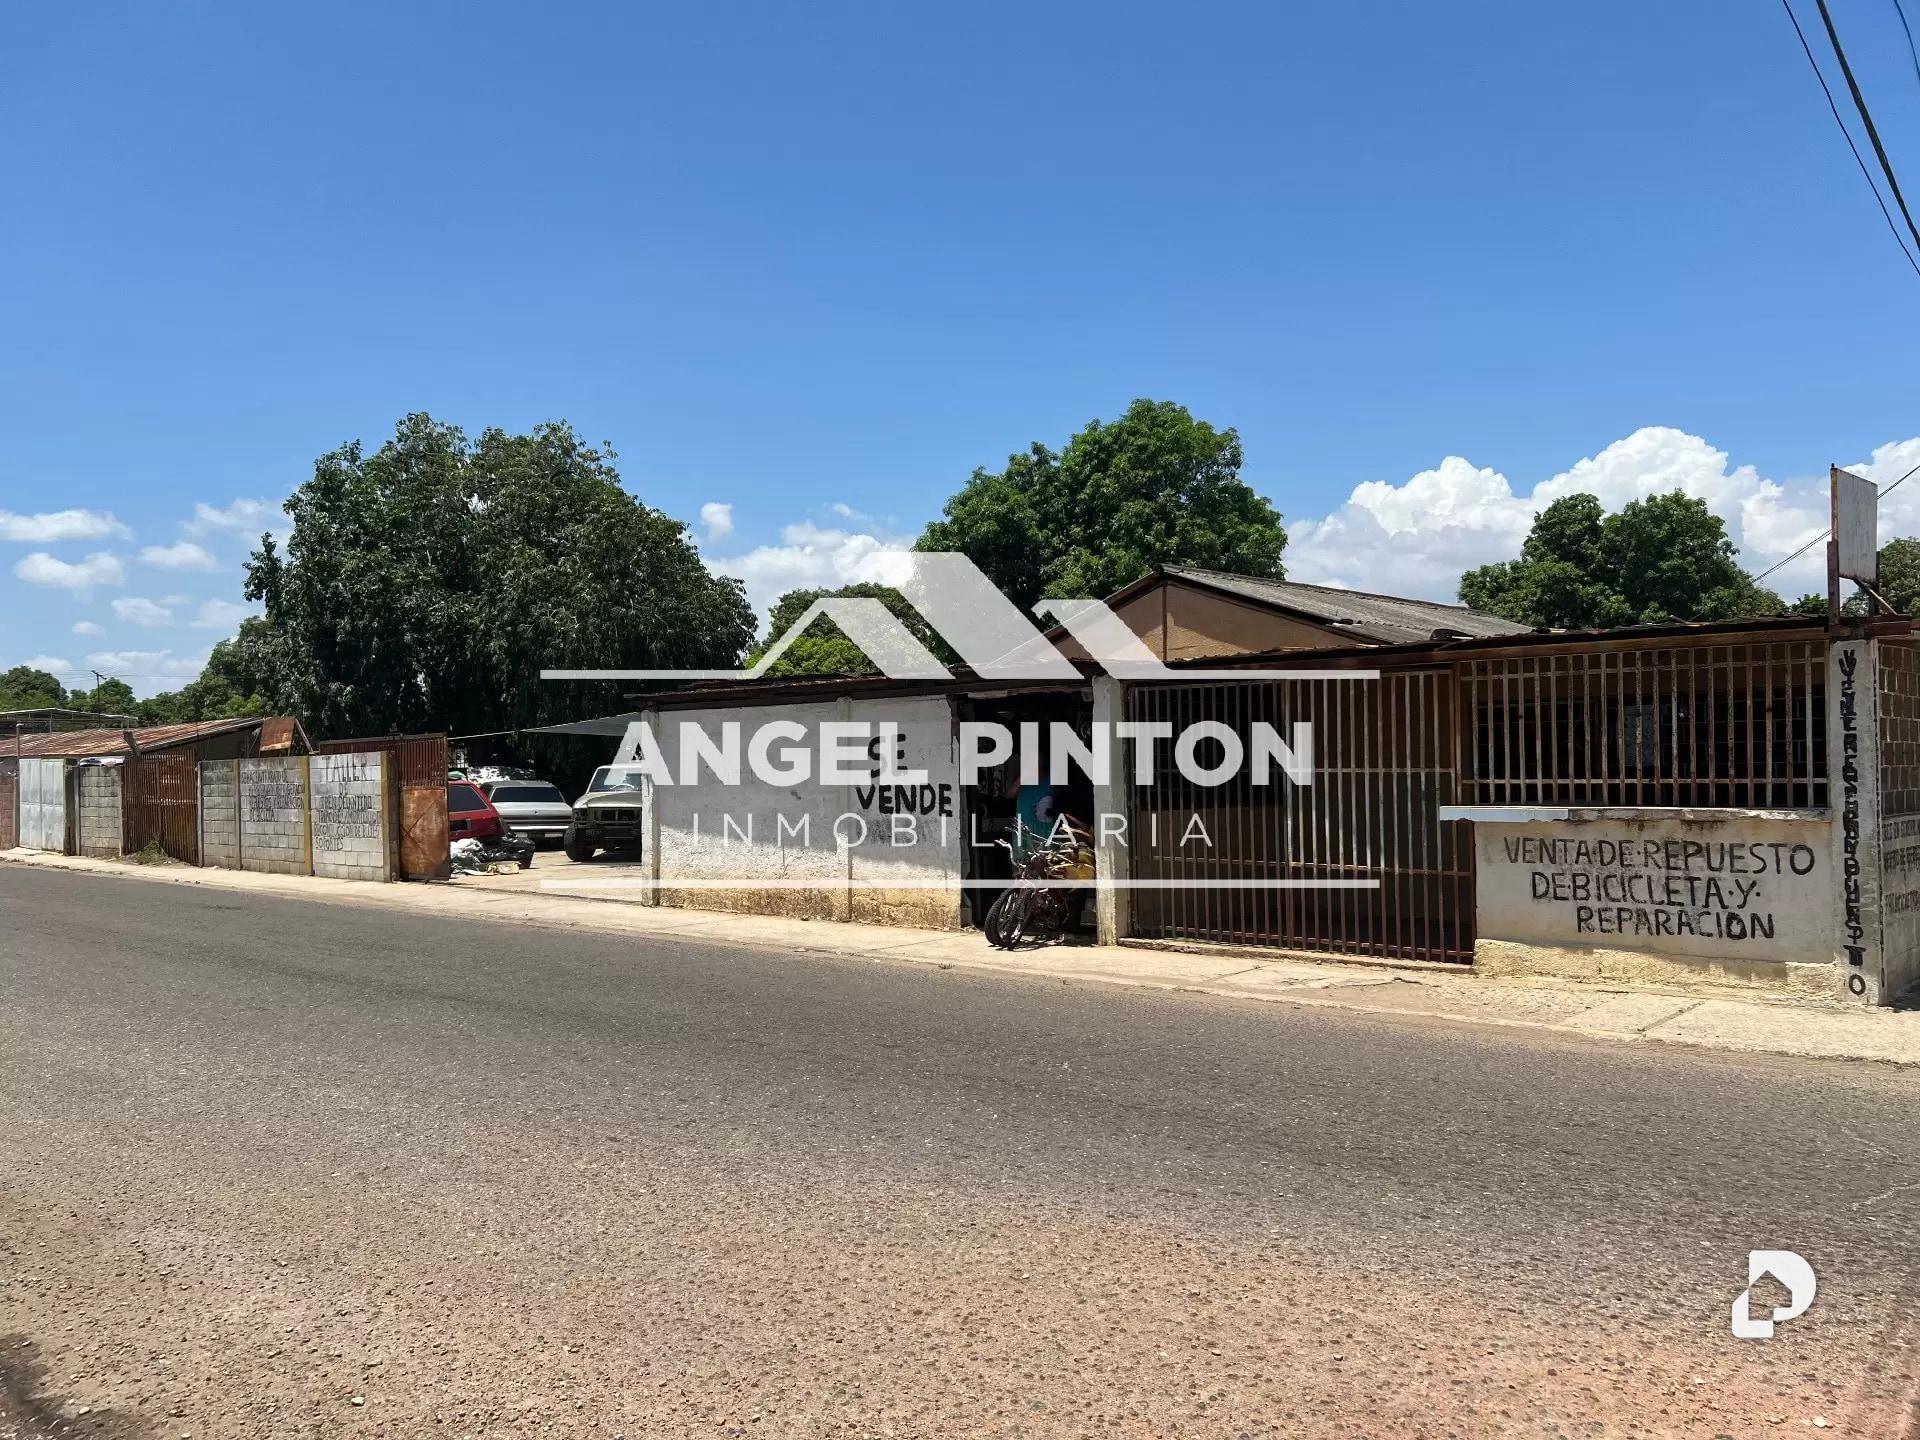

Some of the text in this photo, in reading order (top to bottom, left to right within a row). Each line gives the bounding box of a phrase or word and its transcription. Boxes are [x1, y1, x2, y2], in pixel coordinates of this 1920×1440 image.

[856, 783, 953, 817] VENDE
[1644, 840, 1816, 876] REPUESTO
[1577, 905, 1774, 940] REPARACION
